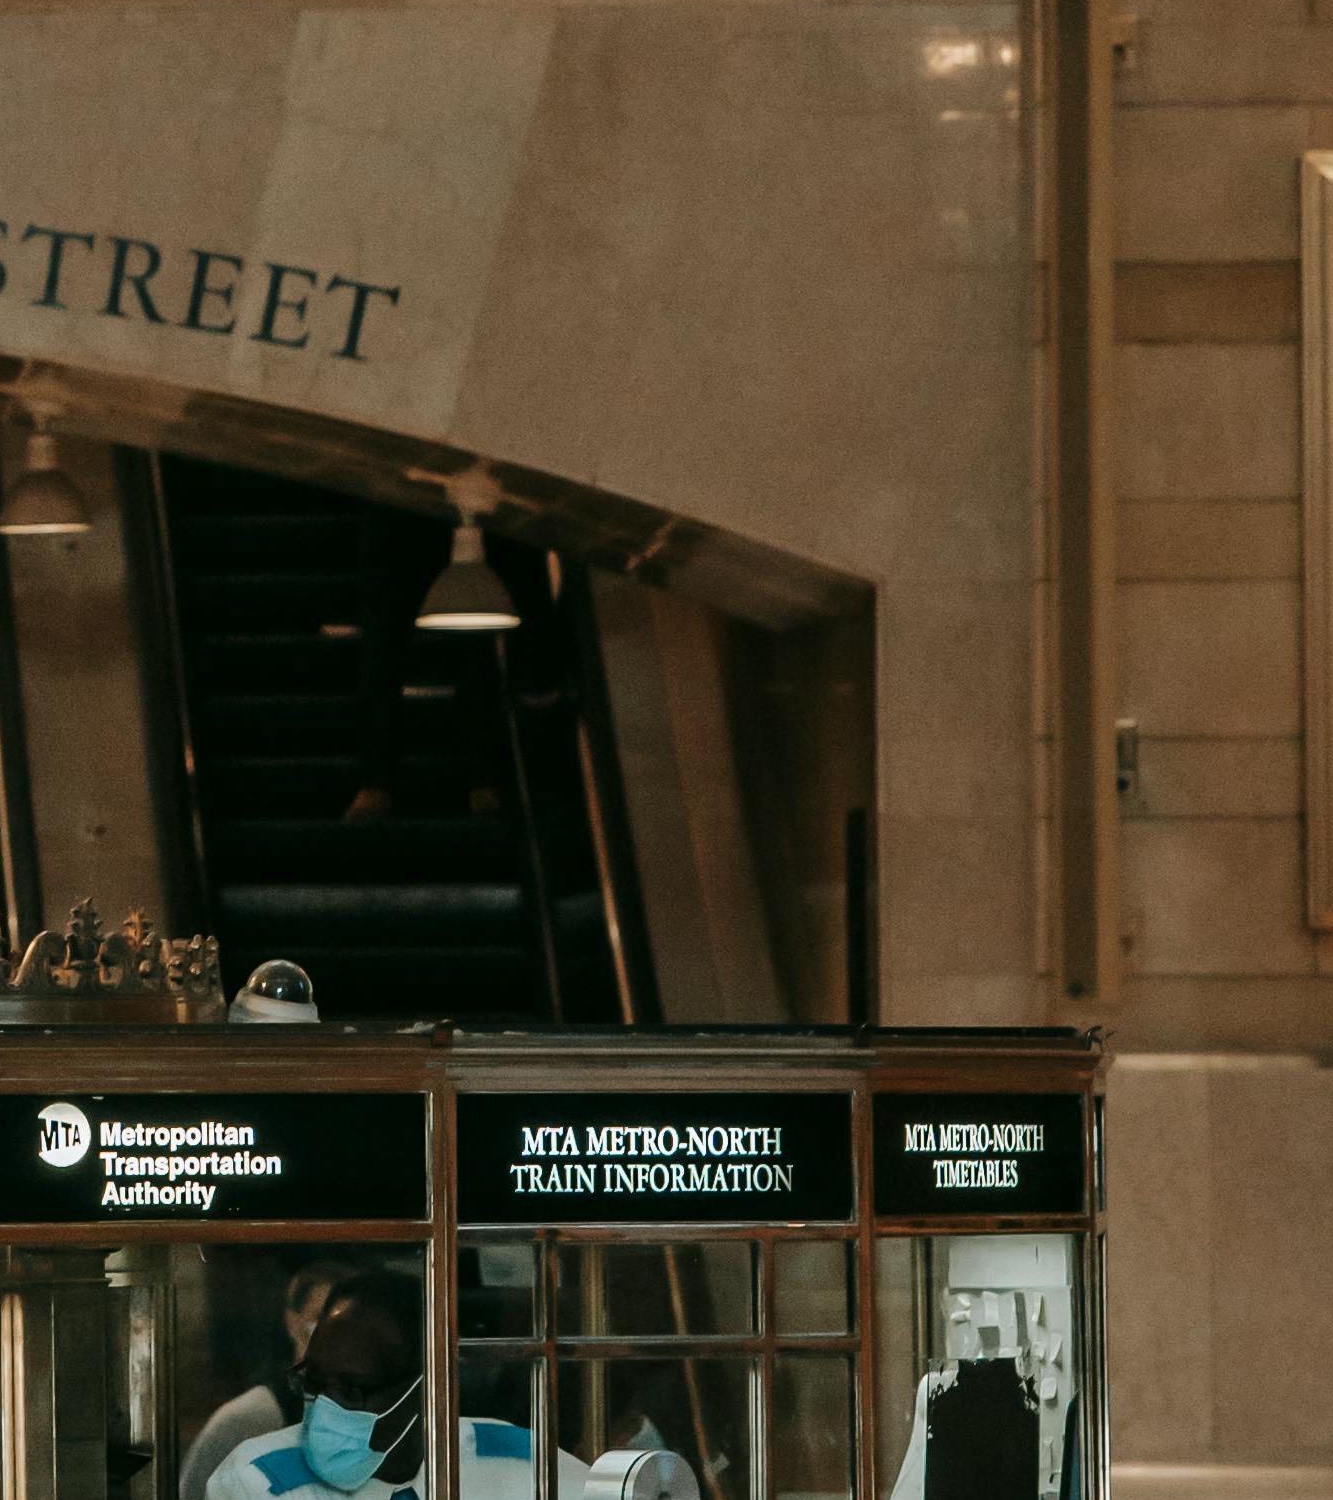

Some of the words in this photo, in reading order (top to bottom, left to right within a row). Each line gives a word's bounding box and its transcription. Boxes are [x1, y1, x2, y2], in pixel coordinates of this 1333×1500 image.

[99, 1122, 255, 1152] Metropolitan
[521, 1127, 581, 1156] MTA
[585, 1126, 782, 1156] METRO-NORTH
[904, 1123, 935, 1152] MTA
[938, 1123, 1044, 1152] METRO-NORTH
[99, 1152, 282, 1181] Transportation
[509, 1164, 597, 1194] TRAIN
[603, 1163, 794, 1193] INFORMATION
[932, 1159, 1019, 1188] TIMETABLES
[101, 1181, 217, 1211] Authority
